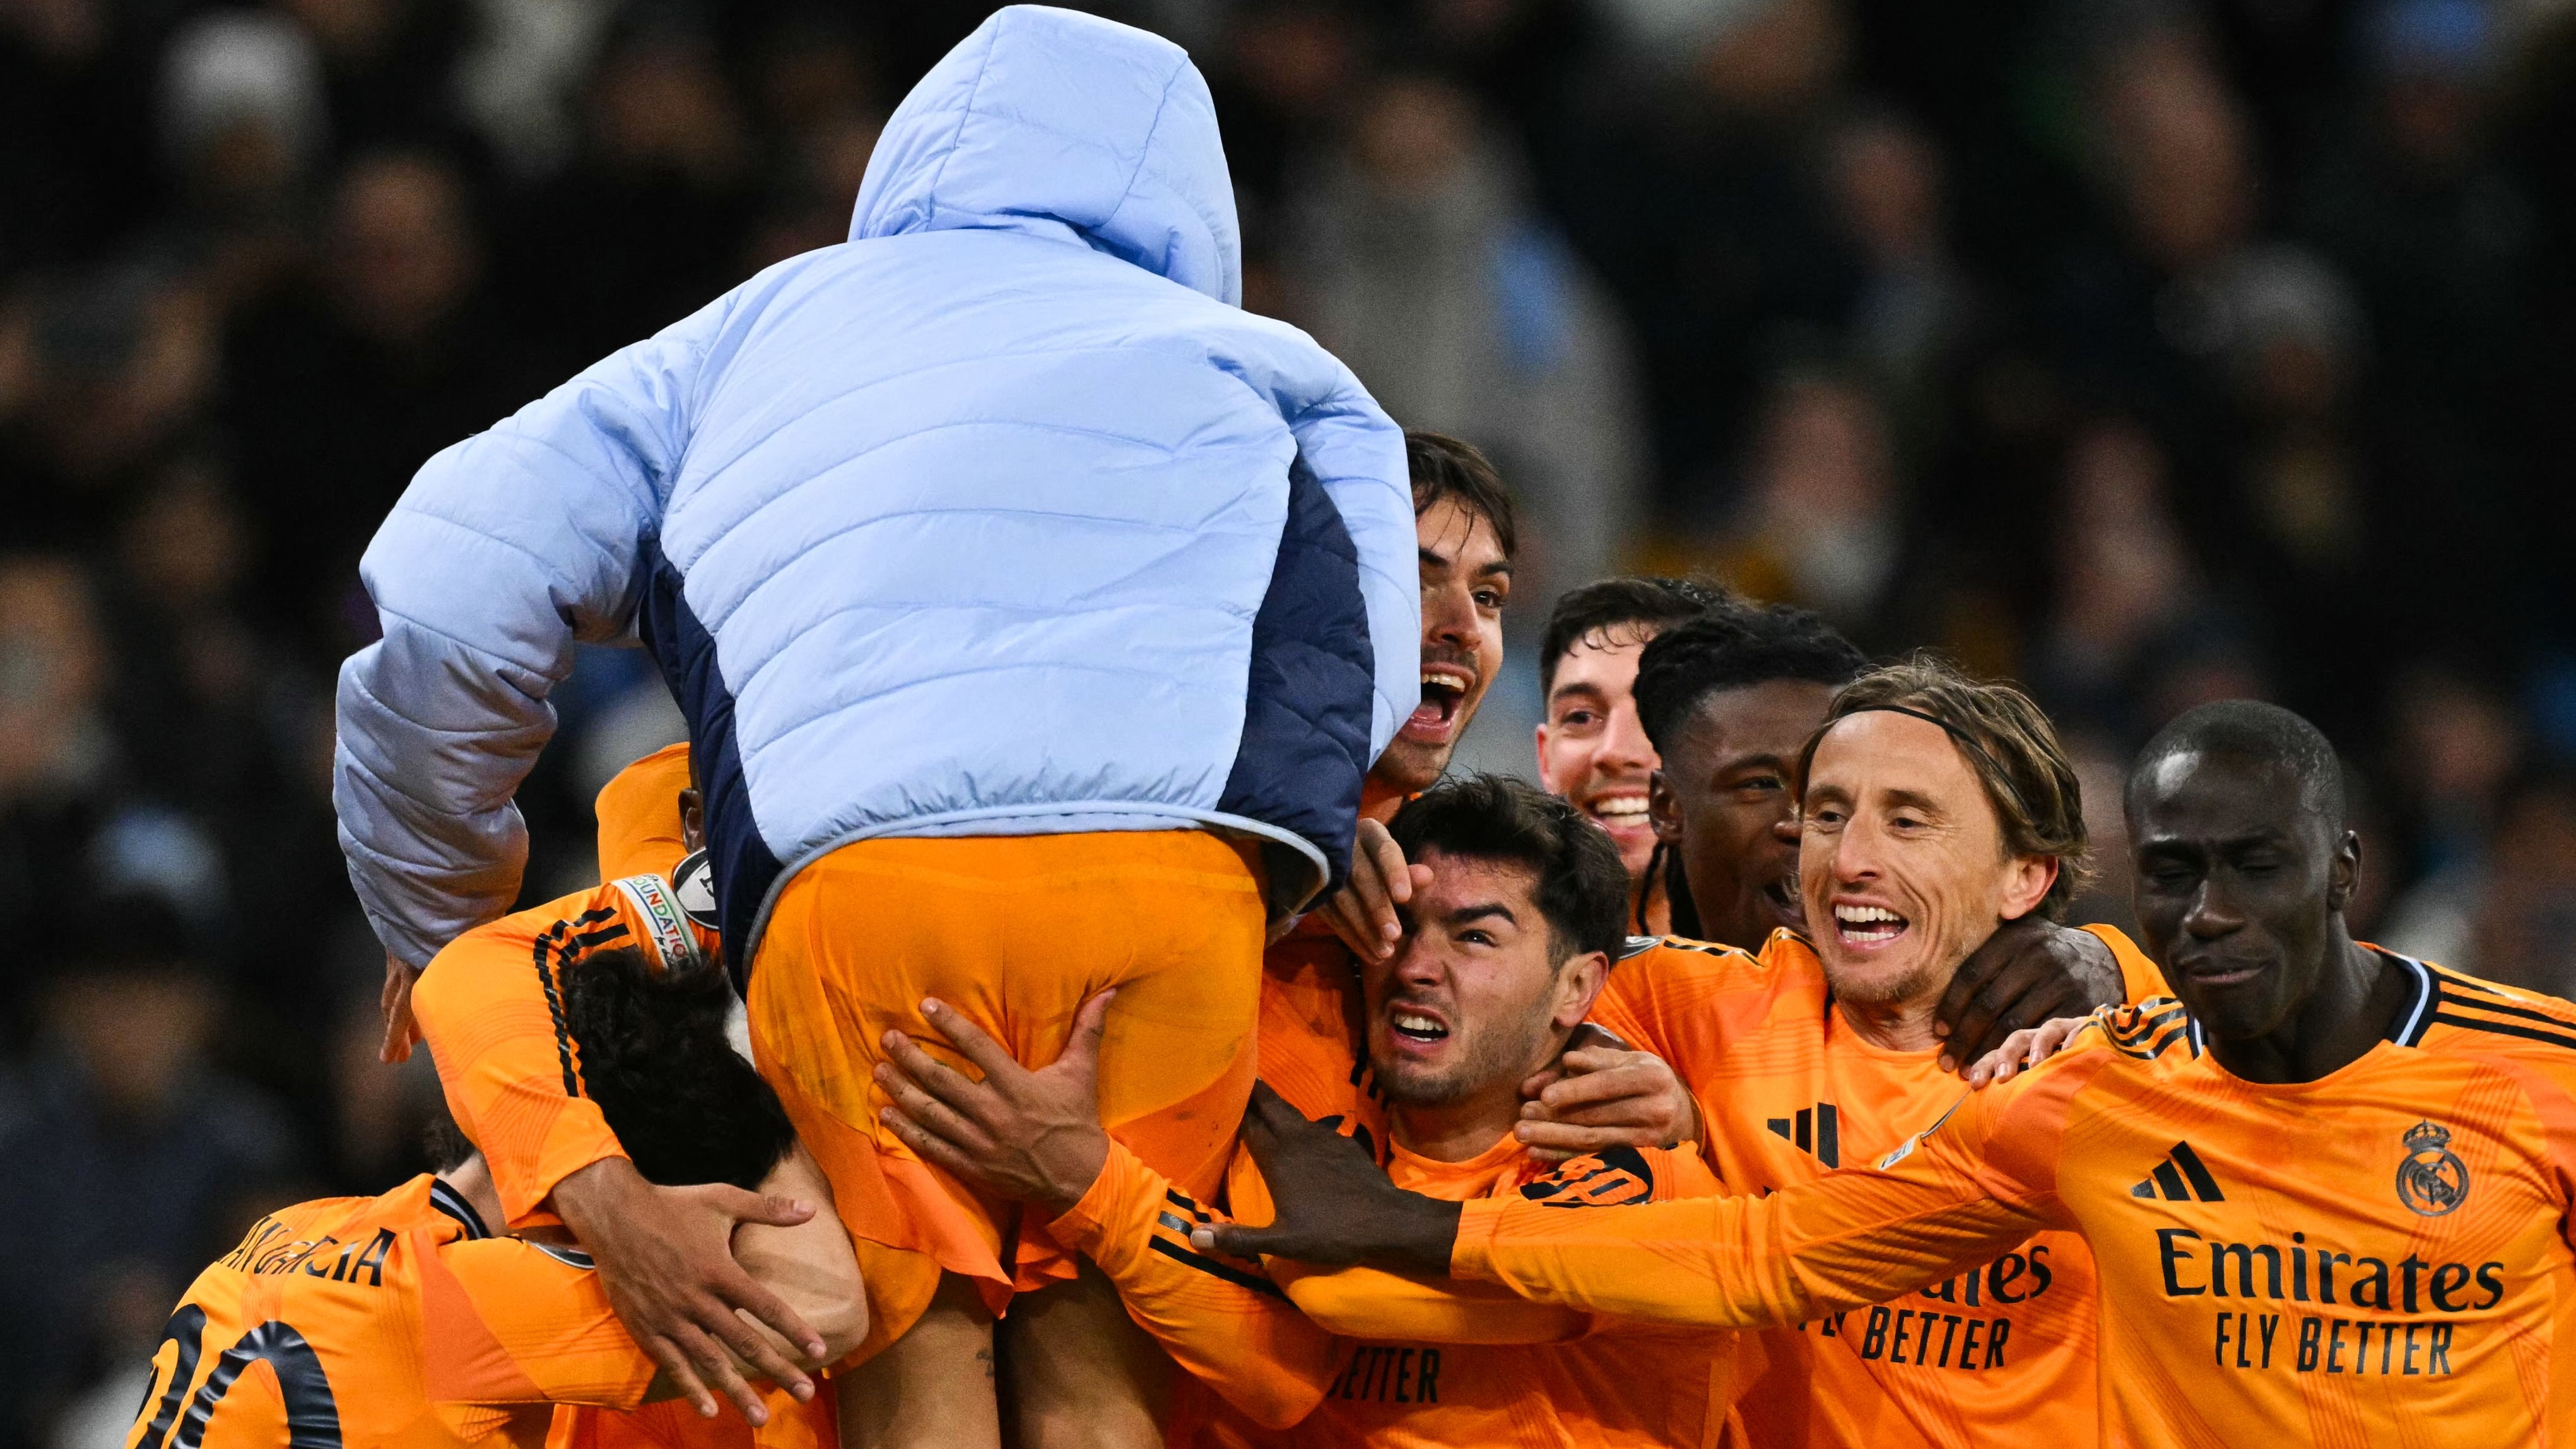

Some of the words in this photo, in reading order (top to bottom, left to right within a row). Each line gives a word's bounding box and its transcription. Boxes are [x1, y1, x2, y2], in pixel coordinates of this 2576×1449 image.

[633, 877, 686, 958] OUNDATIO
[2156, 1228, 2505, 1313] Emirates
[1861, 1305, 2011, 1370] BETTER
[2215, 1312, 2279, 1369] FLY
[2297, 1316, 2453, 1375] BETTER
